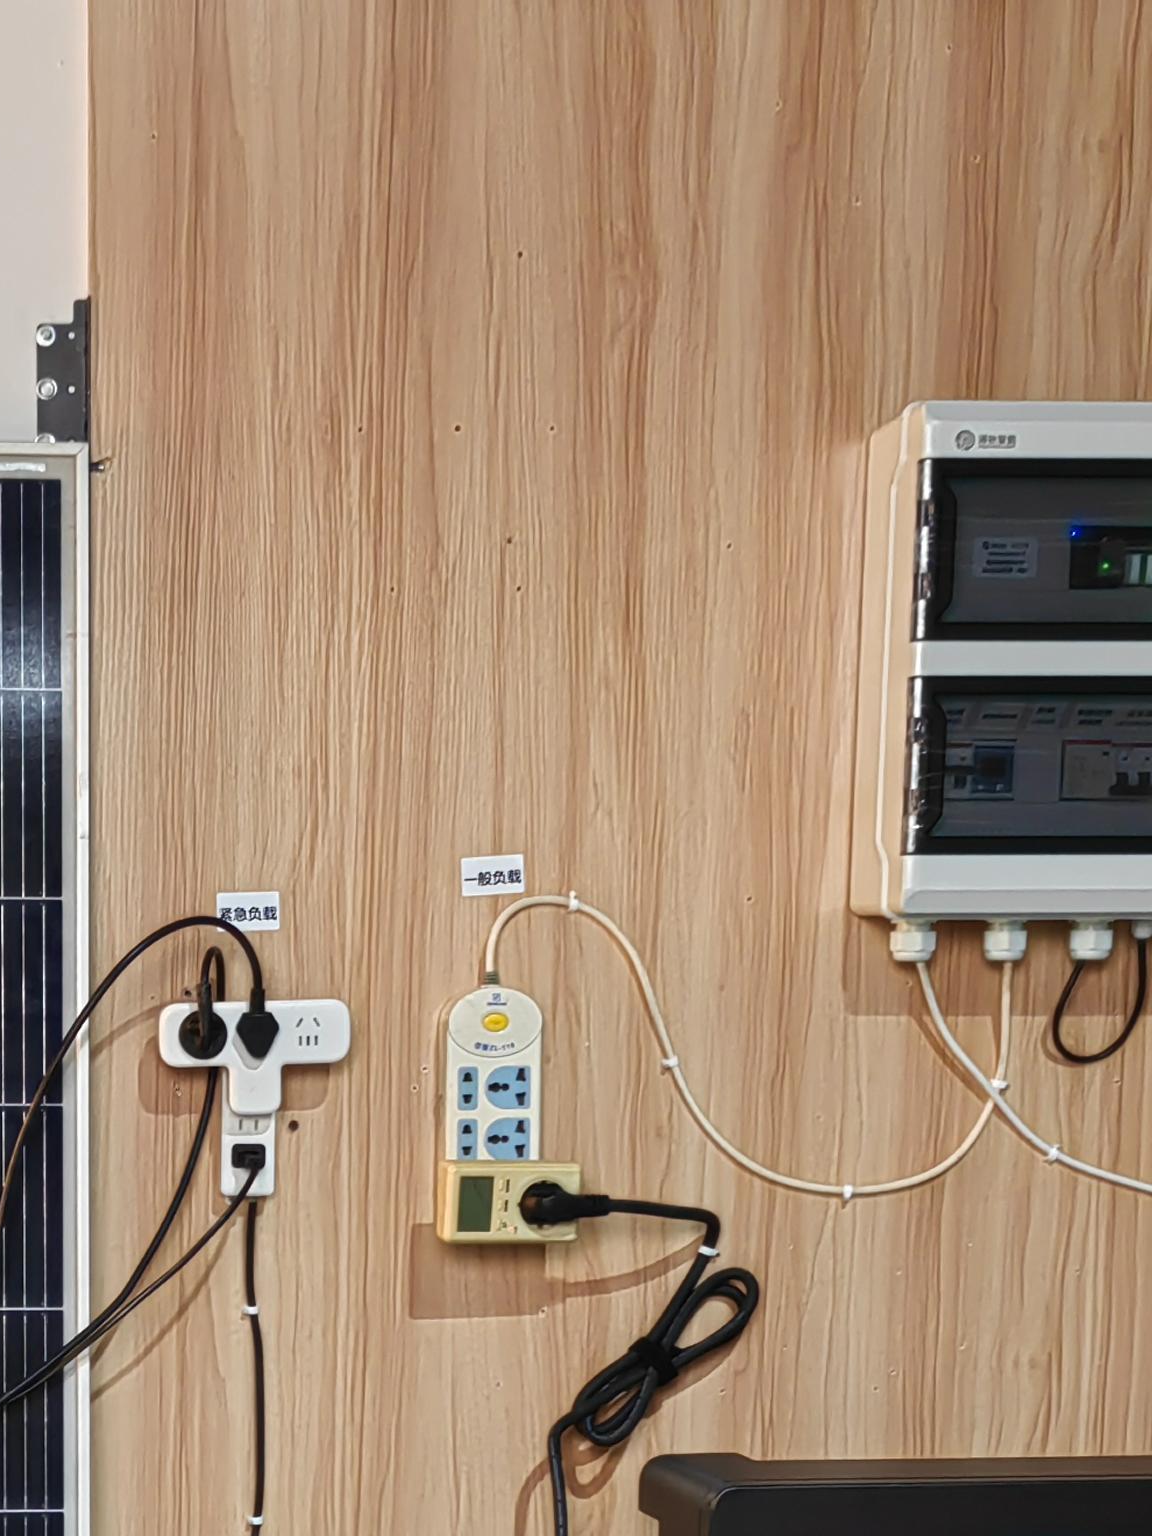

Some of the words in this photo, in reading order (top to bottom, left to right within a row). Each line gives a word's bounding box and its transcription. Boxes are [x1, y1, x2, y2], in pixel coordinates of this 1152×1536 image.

[464, 869, 522, 887] 一般负载
[219, 906, 277, 922] 紧急负载
